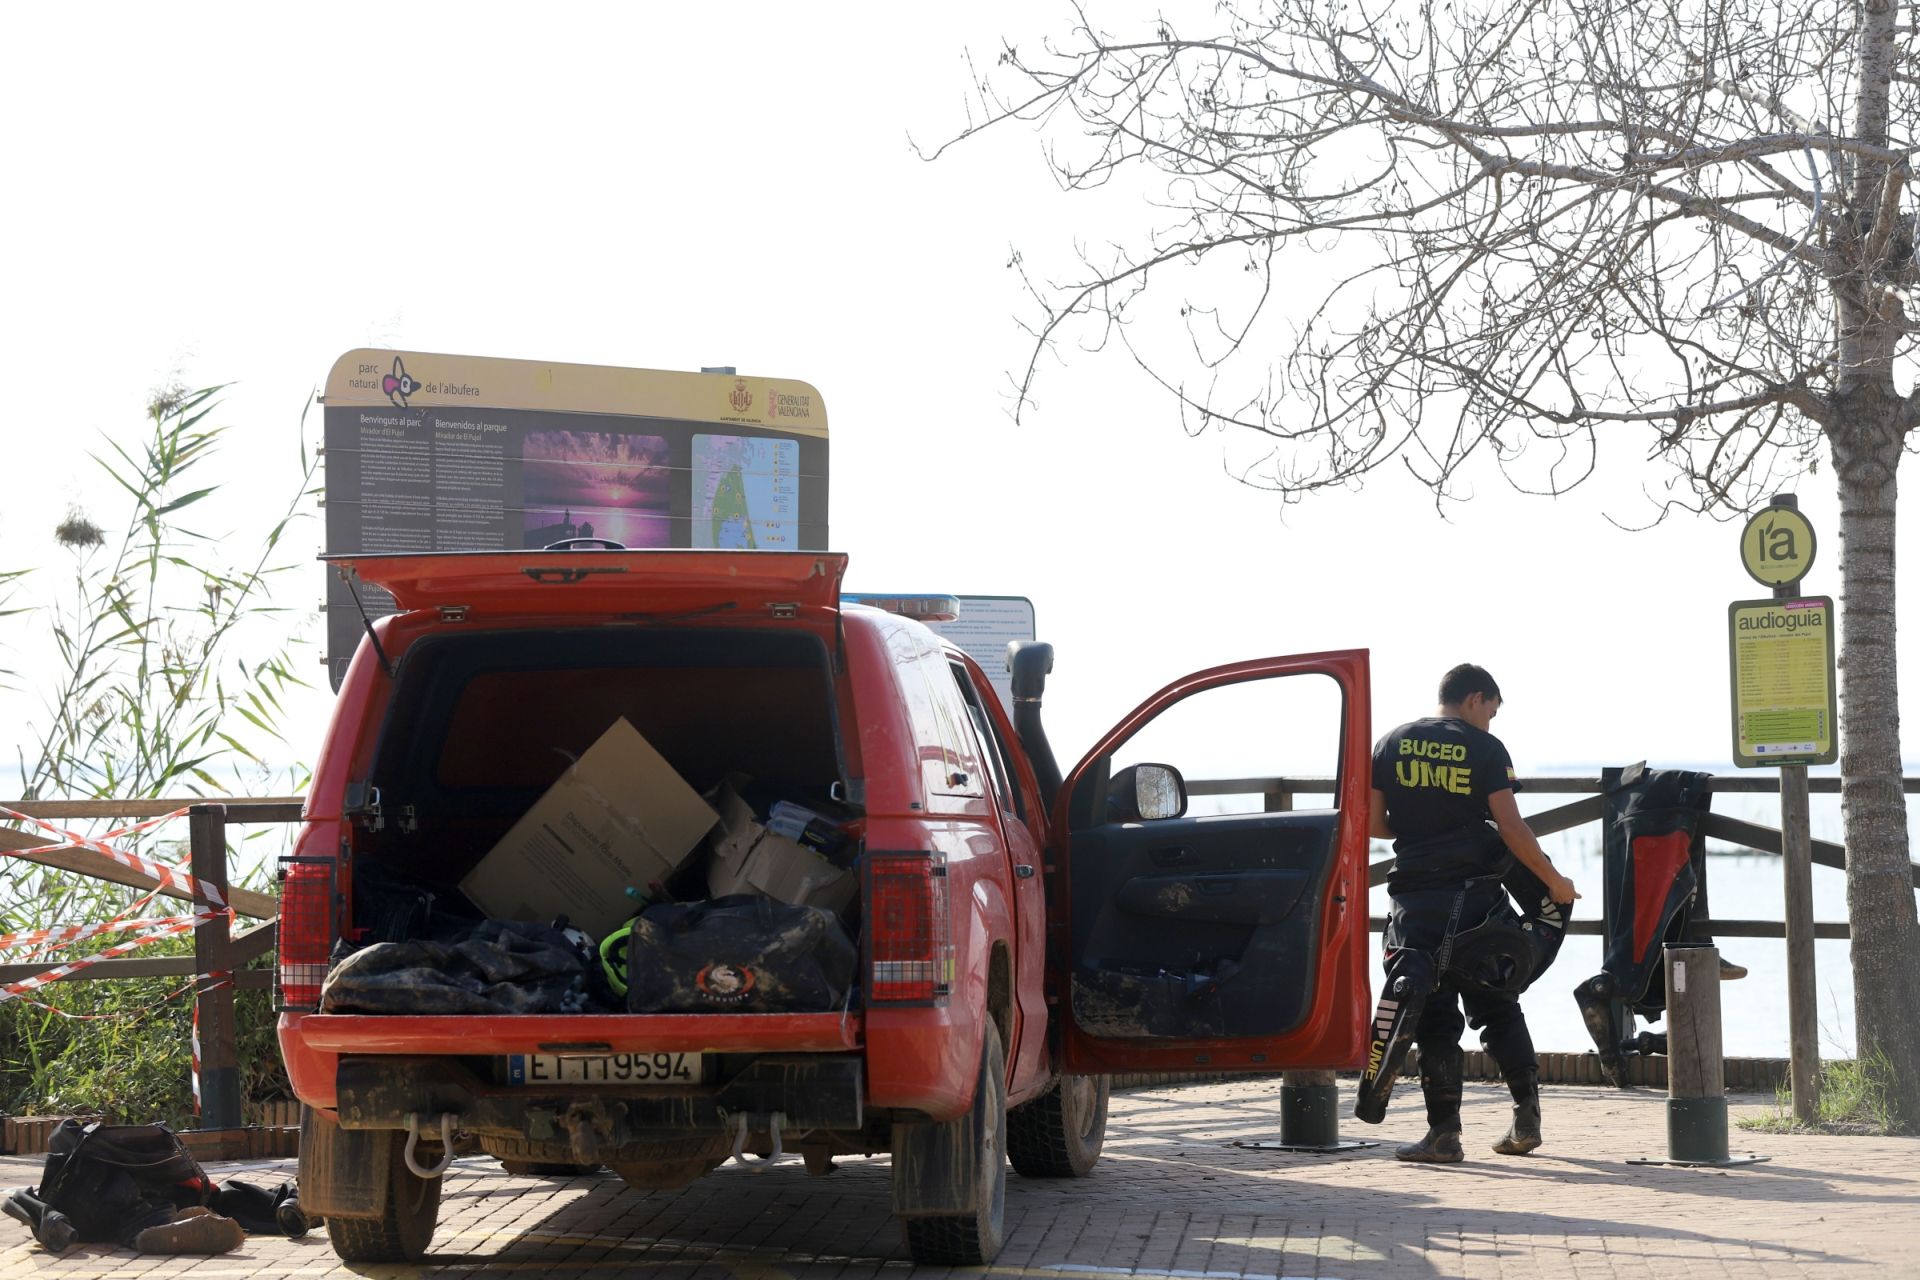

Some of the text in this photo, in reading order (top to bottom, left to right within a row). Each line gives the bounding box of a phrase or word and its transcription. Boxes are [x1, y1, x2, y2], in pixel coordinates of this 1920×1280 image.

[358, 363, 379, 375] parc
[349, 378, 379, 390] natural
[425, 381, 480, 396] de l'albufera
[777, 394, 810, 406] GENERALITAT
[777, 406, 810, 418] VALENCIANA
[360, 414, 422, 428] Benvinguts al parc
[435, 418, 508, 433] Bienvenidos al parque
[1739, 610, 1822, 632] audioguia
[1398, 737, 1468, 763] BUCEO
[1395, 759, 1473, 796] UME
[1364, 1038, 1386, 1081] UME
